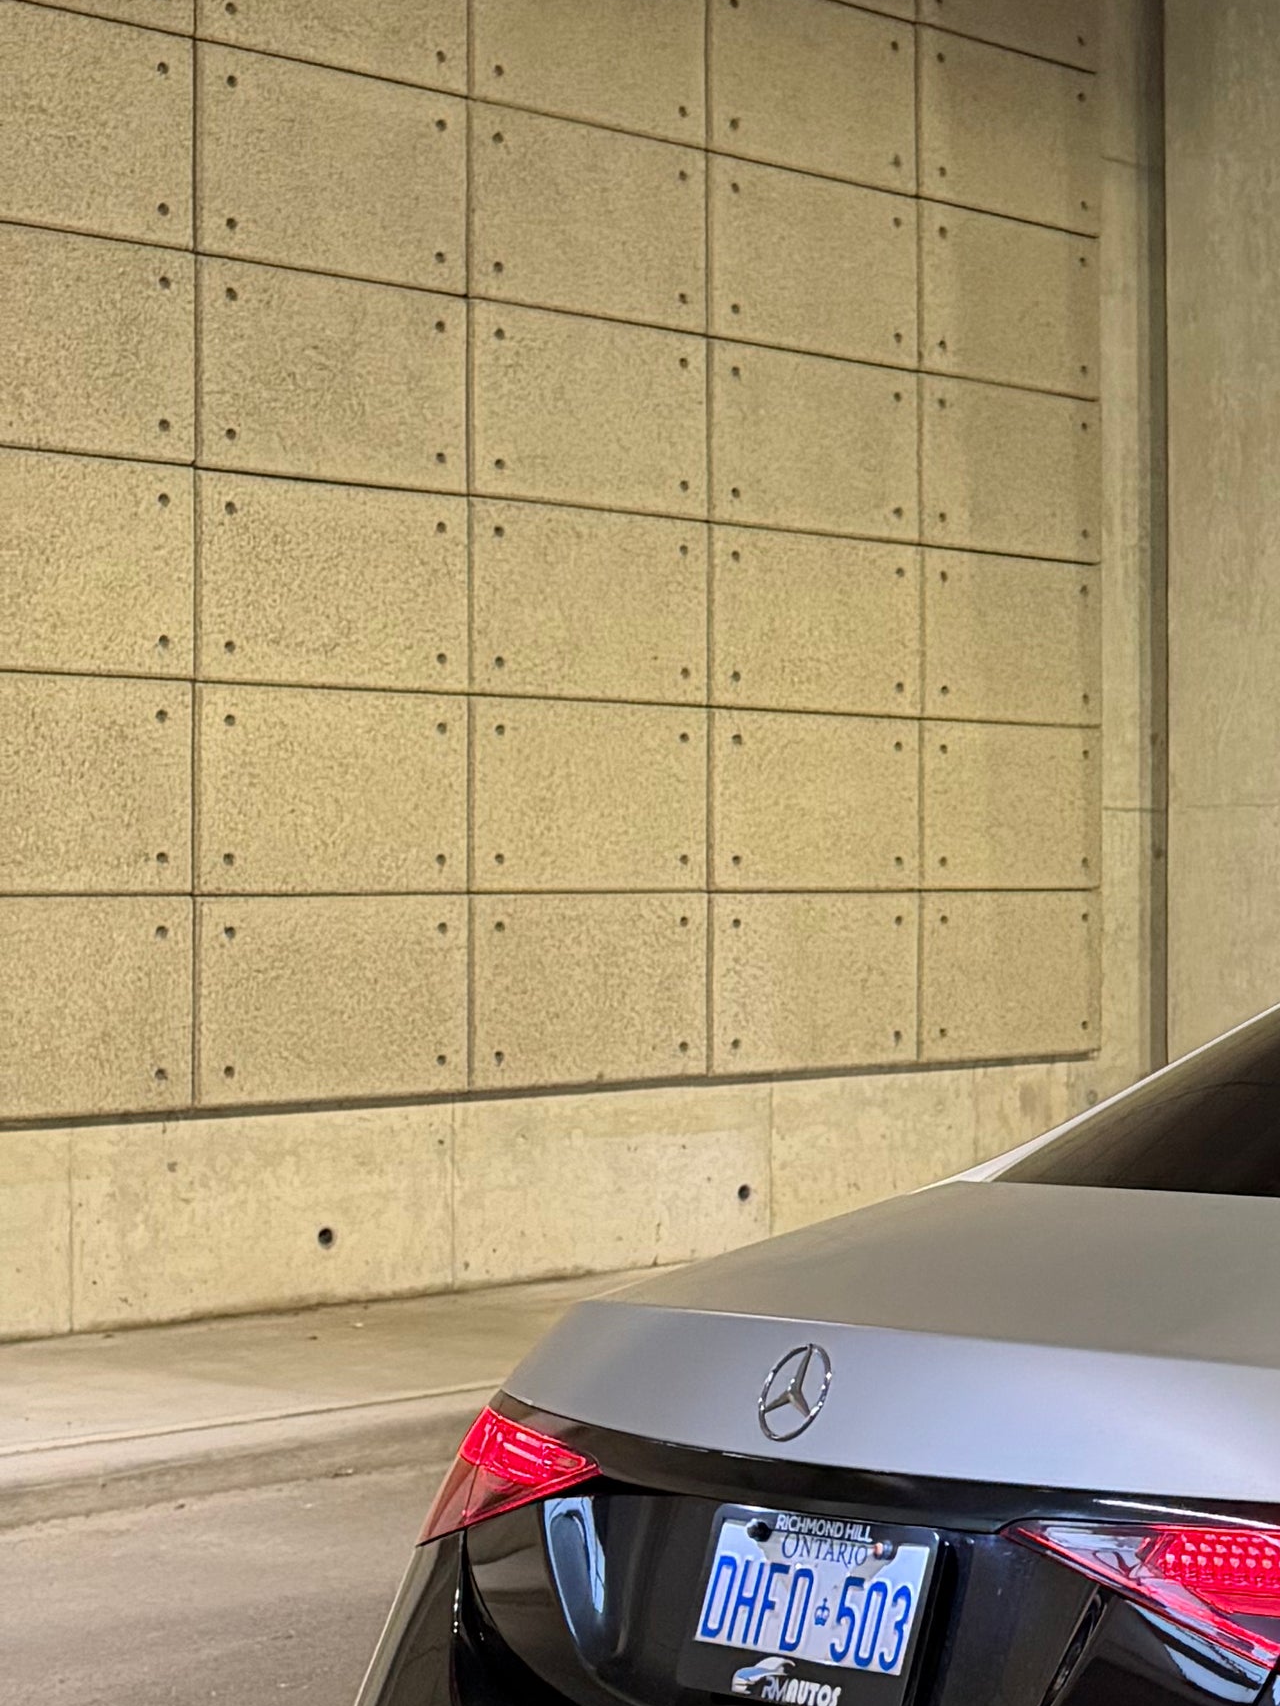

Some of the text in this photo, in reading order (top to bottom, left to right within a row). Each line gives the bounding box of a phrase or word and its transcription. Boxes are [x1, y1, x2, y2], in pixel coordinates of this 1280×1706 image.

[775, 1514, 873, 1543] RICHMOND HILL
[781, 1533, 868, 1569] ONTARIO
[701, 1555, 912, 1671] DHFD 503
